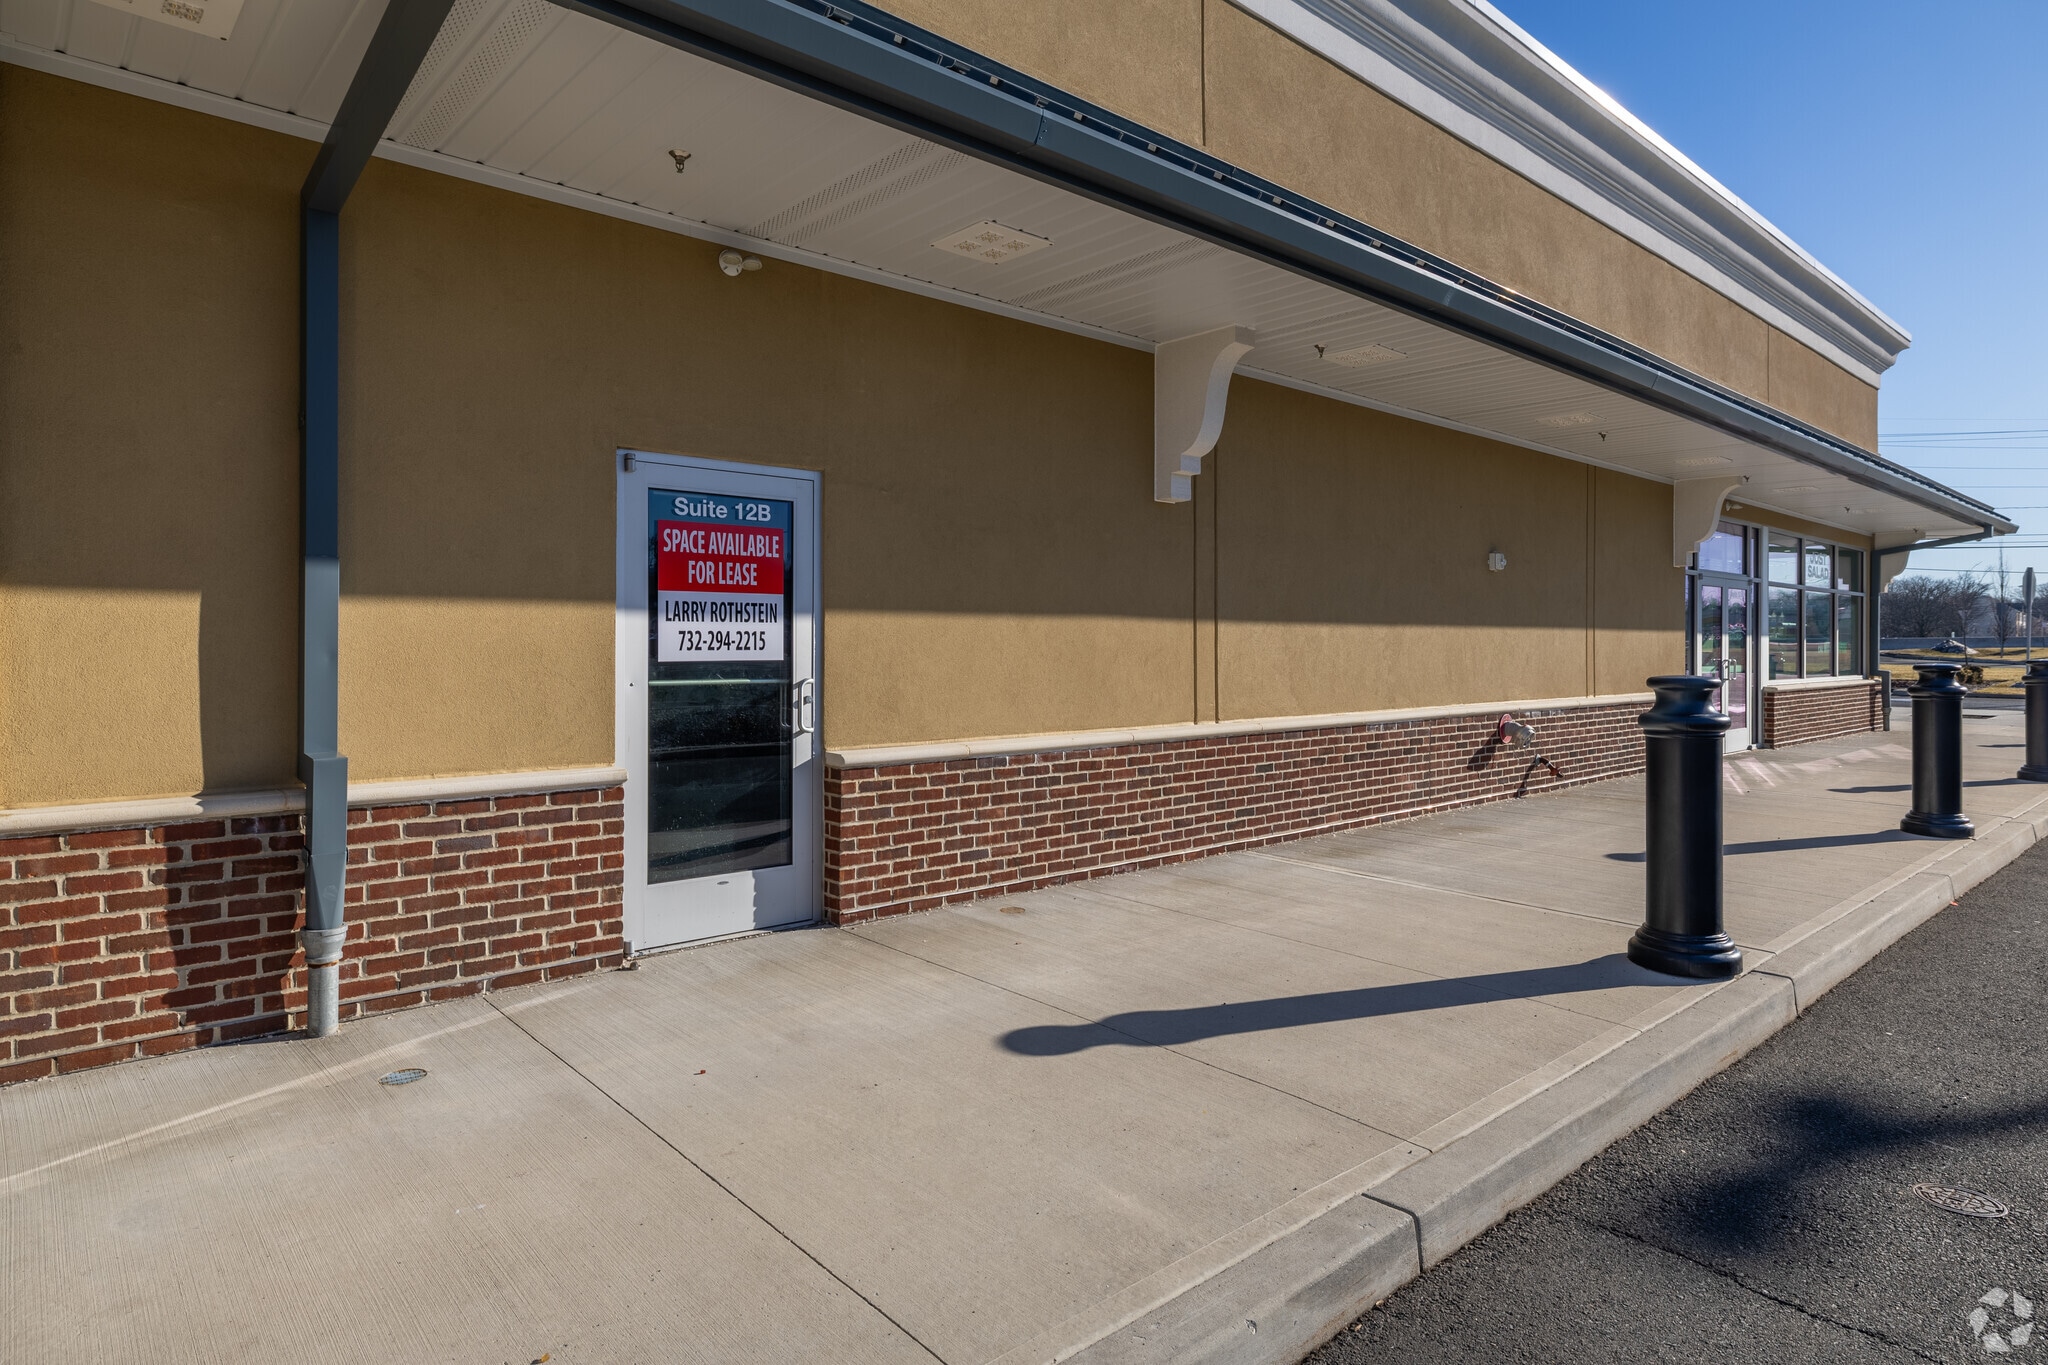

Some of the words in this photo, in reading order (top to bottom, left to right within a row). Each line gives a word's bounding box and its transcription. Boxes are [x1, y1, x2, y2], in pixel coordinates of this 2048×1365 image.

[674, 497, 728, 519] Suite
[734, 502, 772, 522] 12B
[663, 528, 706, 554] SPACE
[708, 531, 780, 558] AVAILABLE
[688, 560, 715, 584] FOR
[718, 561, 758, 586] LEASE
[1807, 565, 1828, 579] SALAD
[665, 600, 708, 622] LARRY
[710, 601, 778, 623] ROTHSTEIN
[678, 630, 766, 651] 732-294-2215
